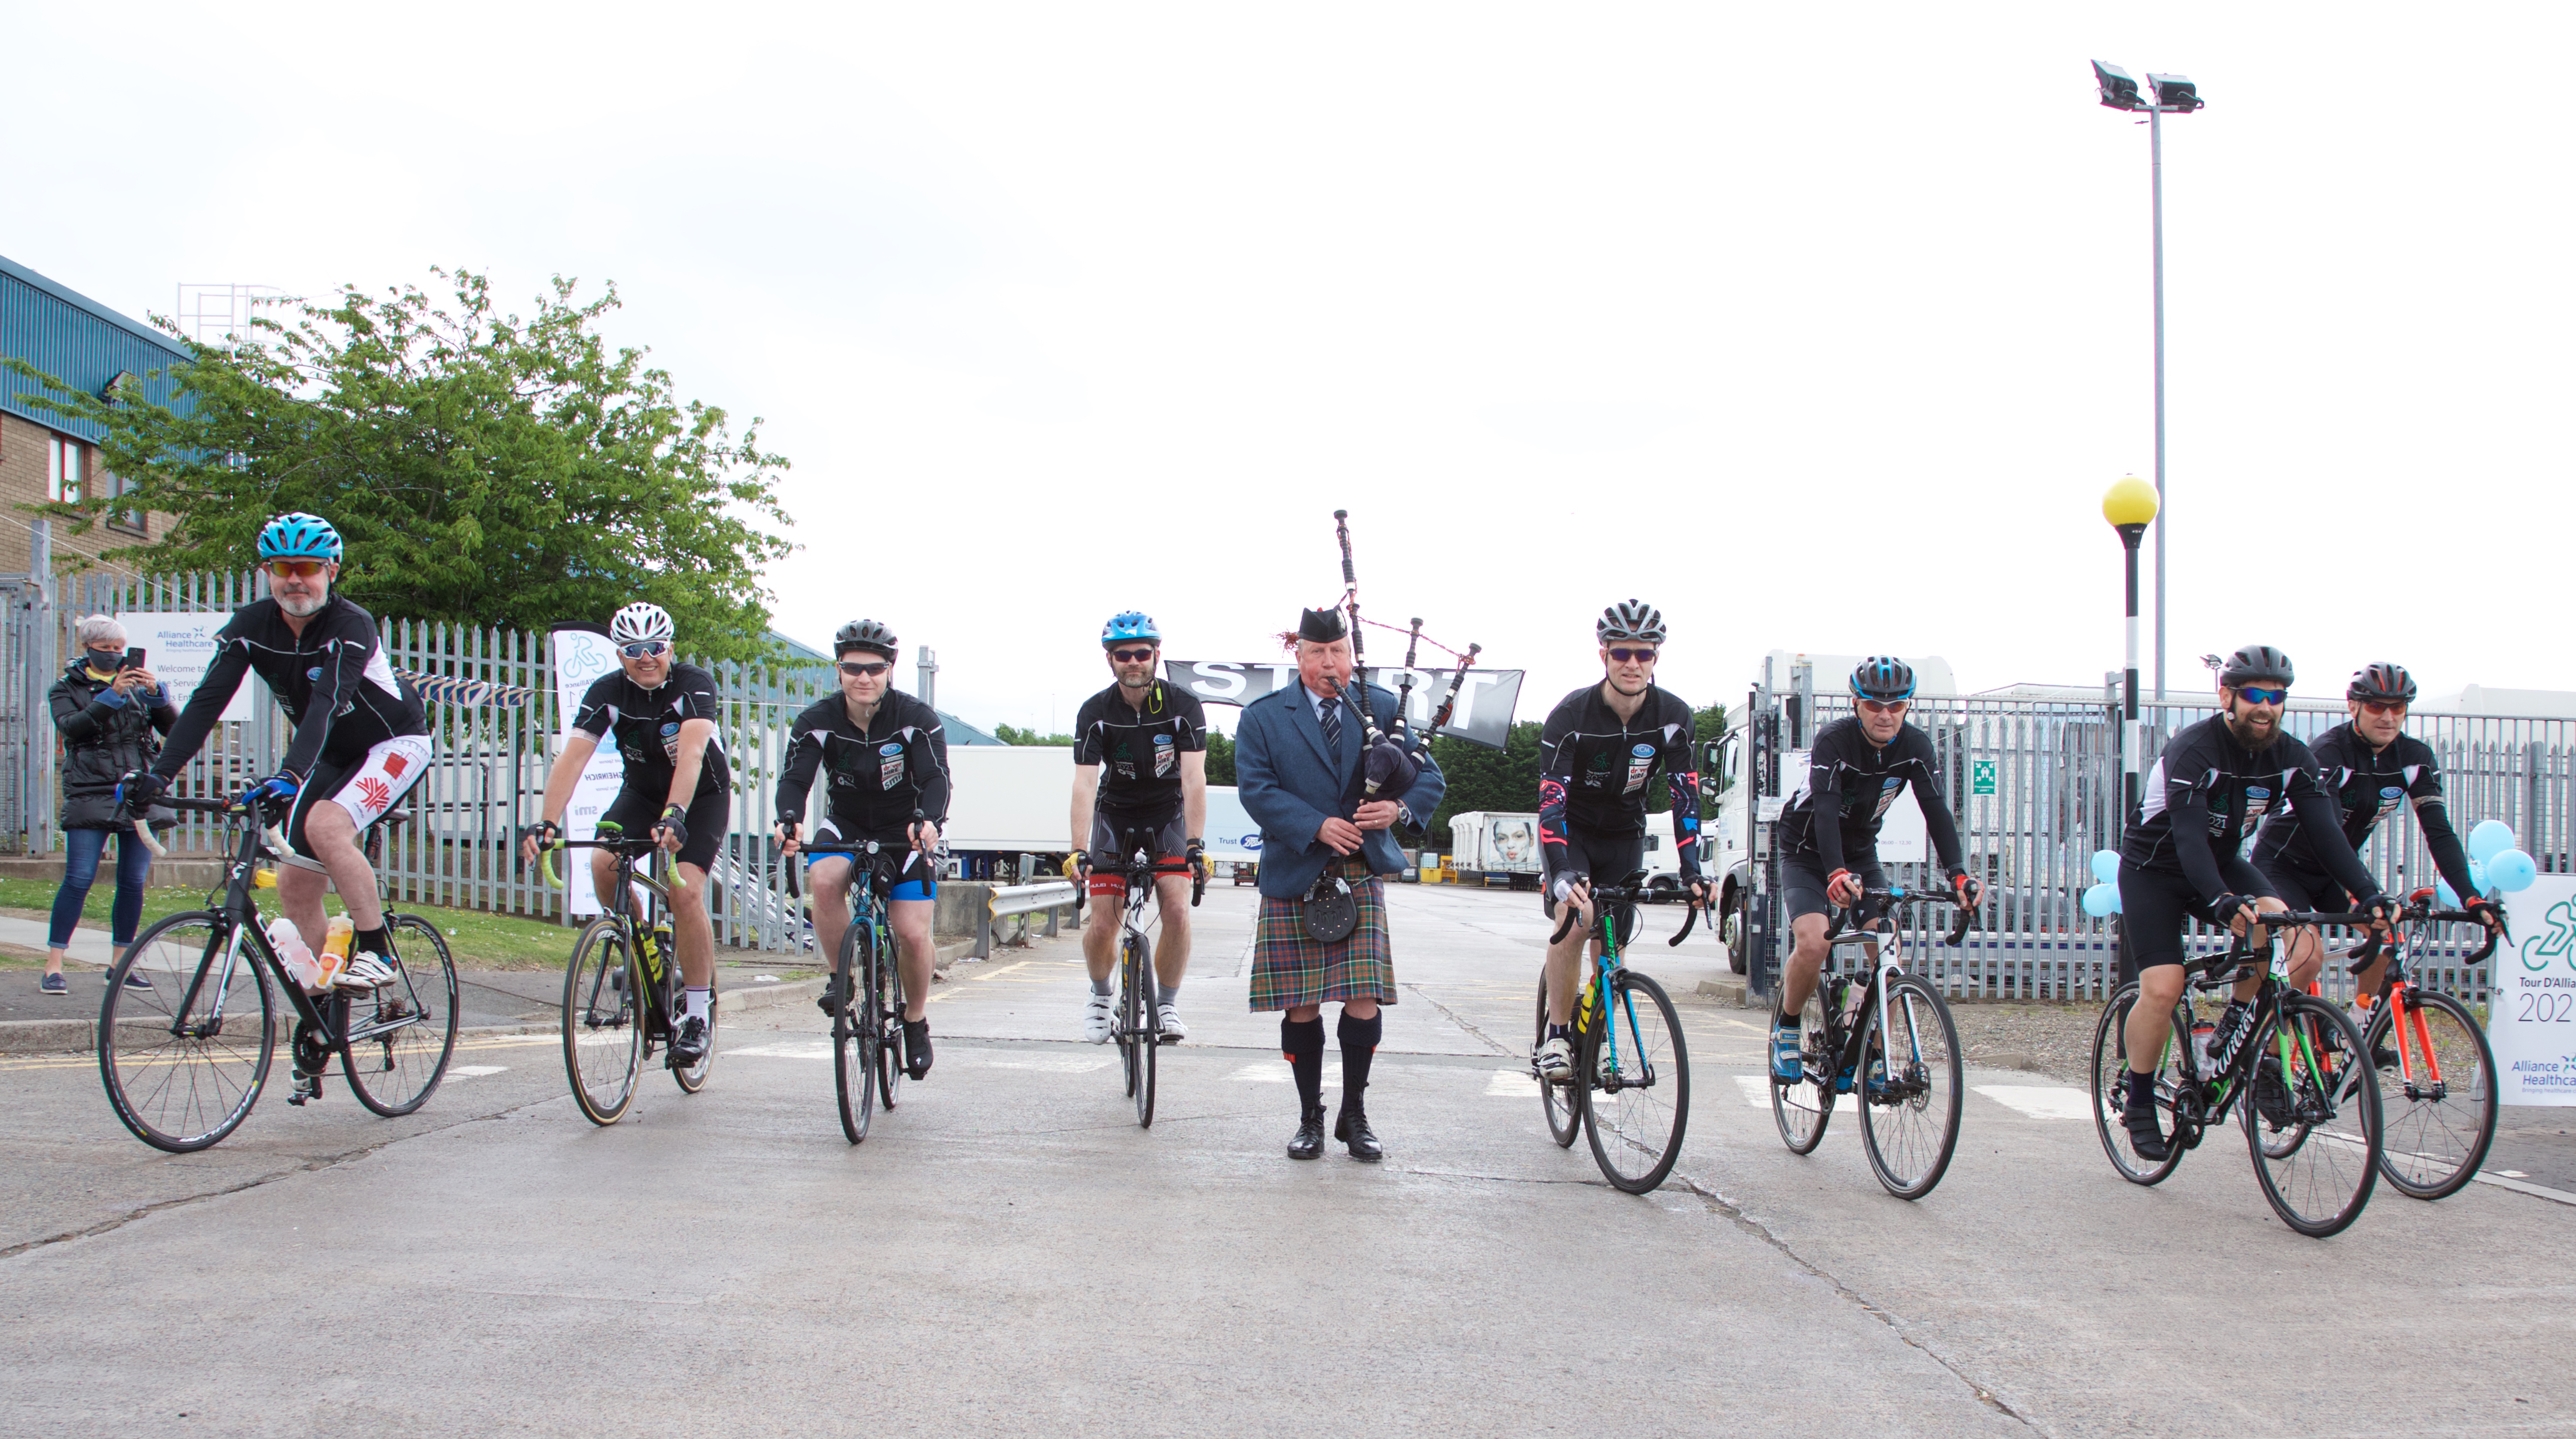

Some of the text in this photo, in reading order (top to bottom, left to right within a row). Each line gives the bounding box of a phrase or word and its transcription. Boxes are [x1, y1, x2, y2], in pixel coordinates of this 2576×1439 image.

[1191, 661, 1498, 730] STRT
[884, 768, 898, 776] HIRE
[884, 774, 901, 789] smi
[1242, 836, 1264, 847] Boo
[255, 912, 298, 983] CUBE
[2519, 977, 2576, 987] Tour D'Allia
[2518, 993, 2573, 1022] 202
[2211, 998, 2259, 1078] Wilier
[2511, 1060, 2559, 1072] Alliance
[2523, 1074, 2576, 1086] Healthca
